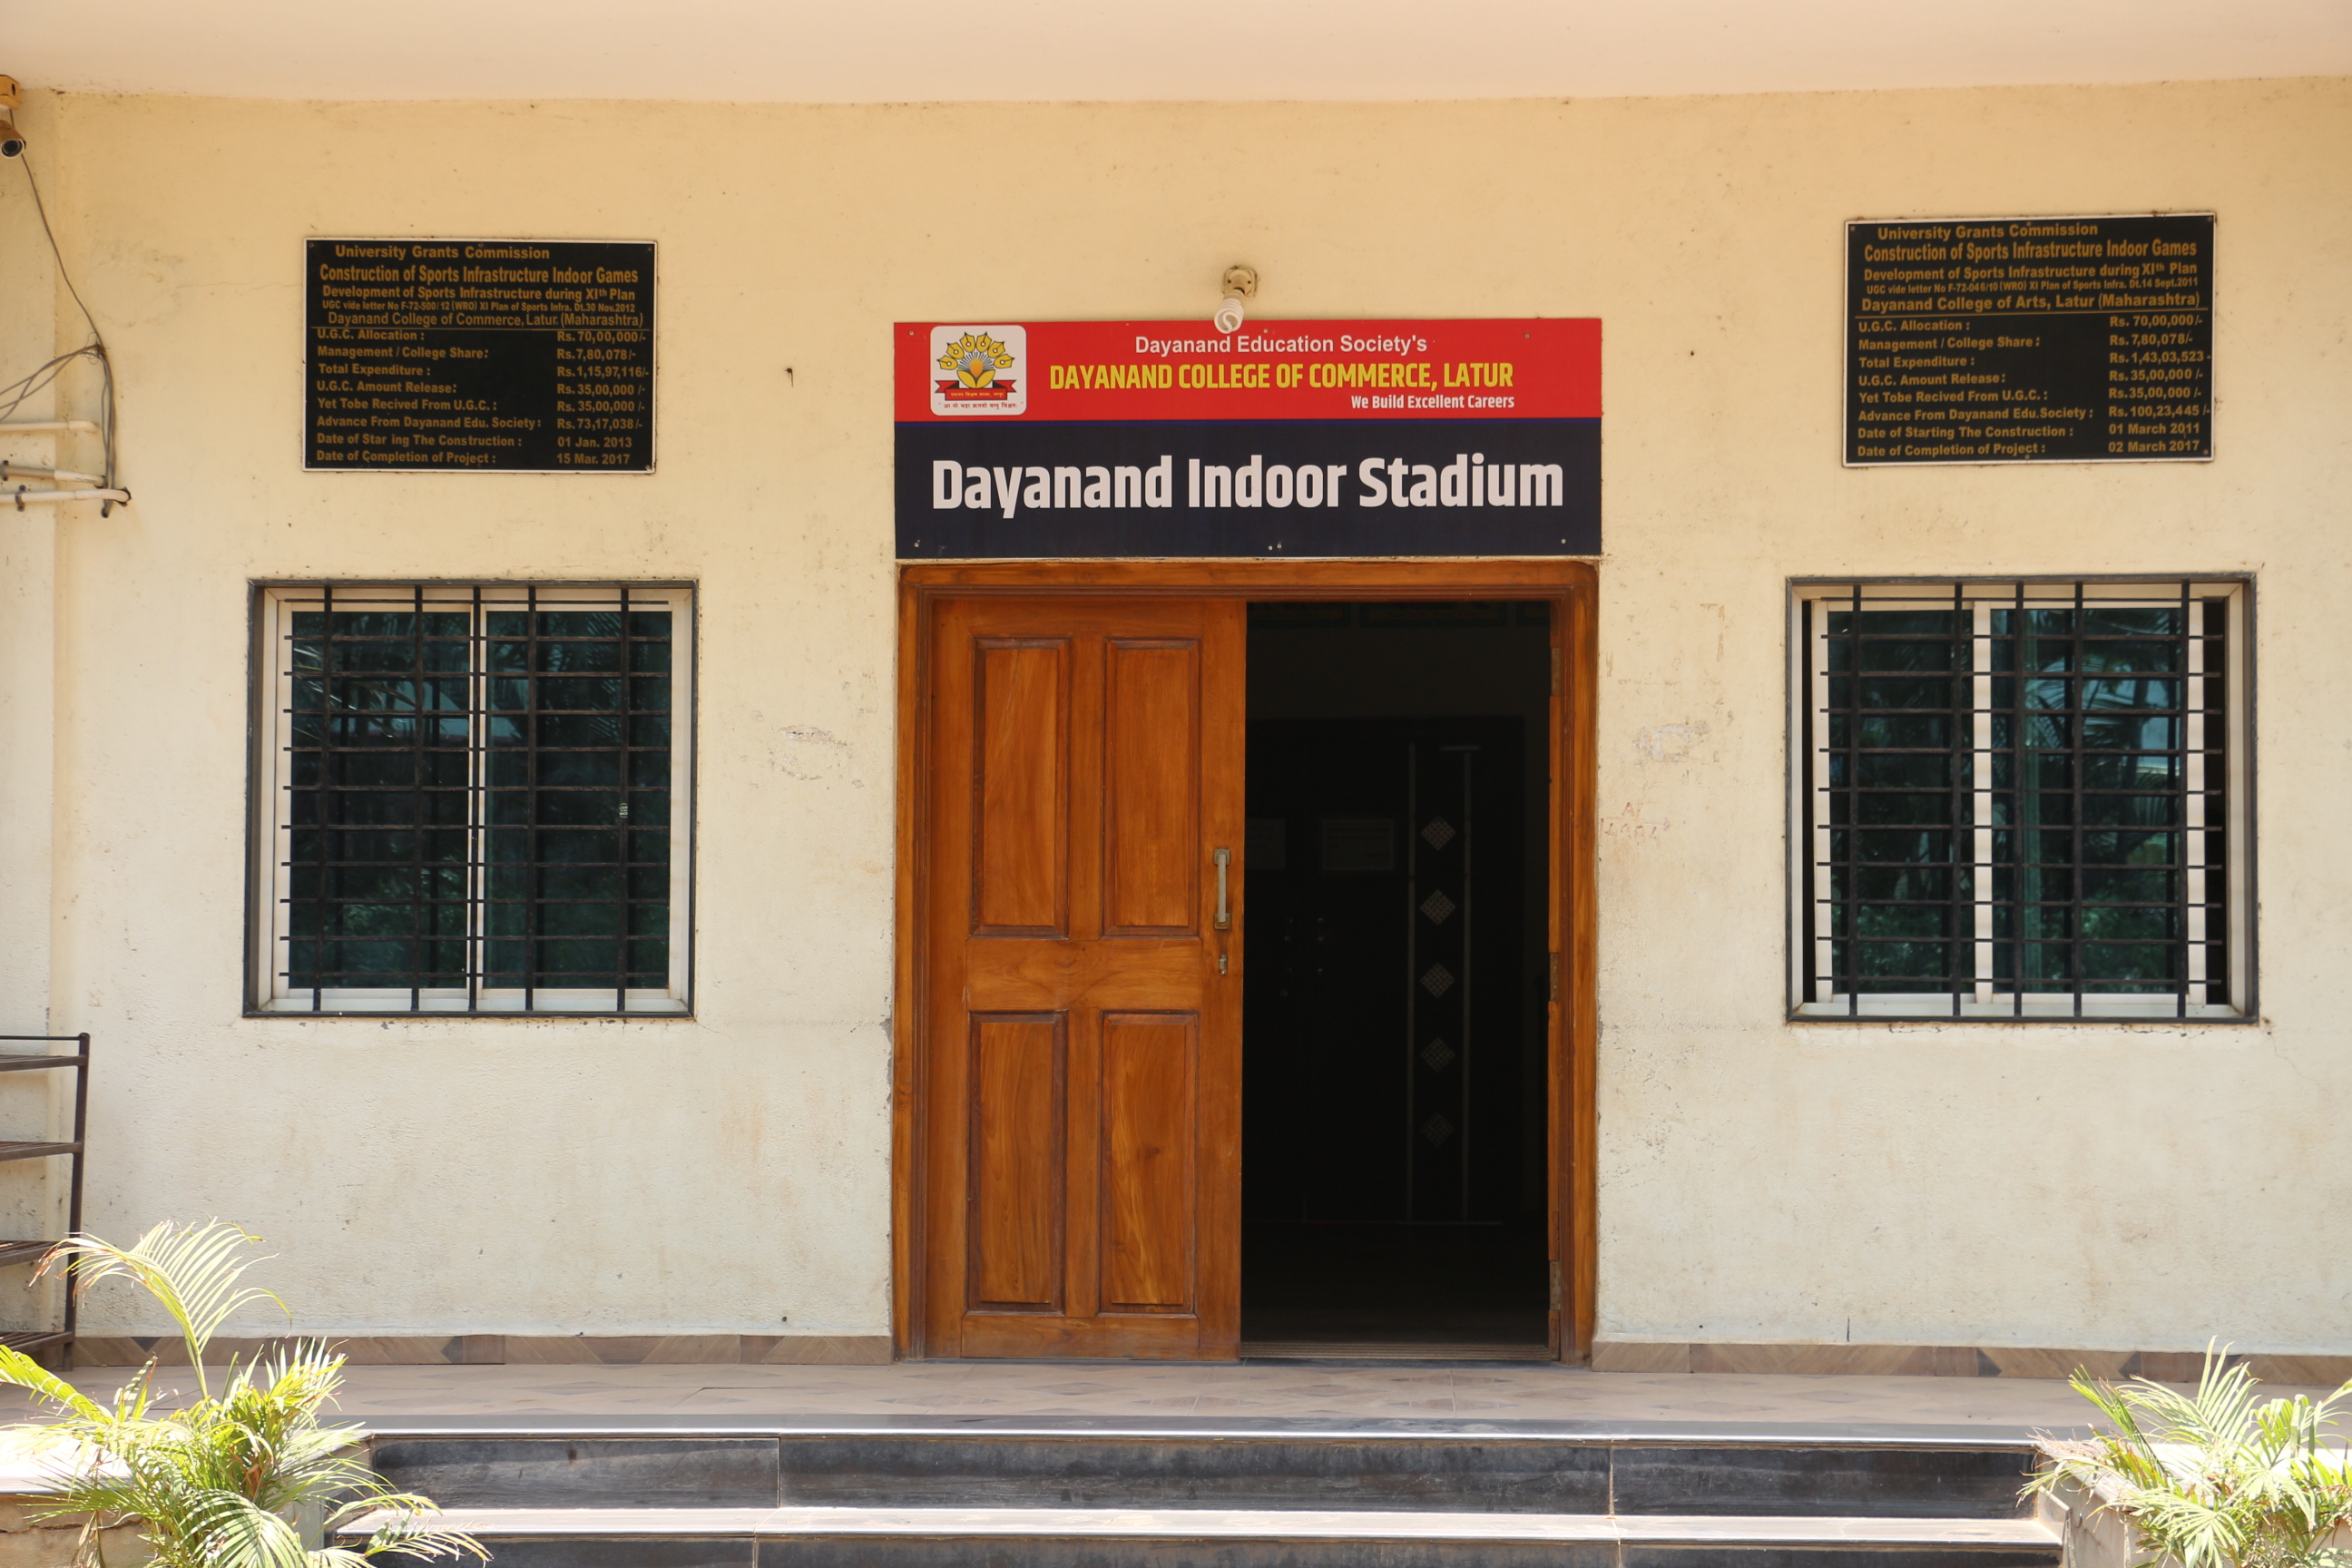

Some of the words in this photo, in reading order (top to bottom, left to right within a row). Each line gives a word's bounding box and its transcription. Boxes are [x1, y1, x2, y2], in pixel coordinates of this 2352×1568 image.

[1877, 226, 1951, 241] University
[1955, 225, 2004, 238] Grants
[2009, 222, 2098, 237] Commission
[335, 244, 407, 260] University
[412, 245, 458, 258] Grants
[465, 245, 549, 259] Commission
[1864, 243, 1946, 261] Construction
[1950, 242, 1964, 260] of
[1966, 241, 2009, 263] Sports
[2013, 240, 2102, 259] Infrastructure
[2106, 240, 2149, 256] Indoor
[2151, 238, 2196, 256] Games
[319, 263, 399, 281] Construction
[403, 264, 416, 281] of
[418, 264, 459, 285] Sports
[463, 265, 549, 282] Infrastructure
[553, 266, 593, 283] Indoor
[595, 266, 638, 283] Games
[1864, 268, 1944, 282] Development
[1947, 267, 1960, 279] of
[1964, 266, 2004, 281] Sports
[2008, 265, 2096, 278] Infrastructure
[2100, 263, 2140, 279] during
[2170, 261, 2197, 274] Plan
[322, 284, 400, 299] Development
[402, 286, 414, 298] of
[417, 286, 456, 300] Sports
[459, 286, 542, 299] Infrastructure
[545, 288, 583, 303] during
[609, 288, 635, 300] Plan
[1867, 284, 1886, 294] UGC
[1887, 284, 1906, 293] vide
[1907, 284, 1932, 293] letter
[1999, 280, 2026, 291] (WRO)
[2041, 280, 2060, 289] Plan
[2073, 279, 2101, 290] Sports
[2103, 279, 2126, 289] Infra.
[2129, 279, 2152, 288] Dt.14
[2154, 277, 2197, 289] Sept.2011
[321, 299, 340, 309] UGC
[342, 300, 360, 309] vide
[362, 300, 386, 310] letter
[451, 300, 477, 311] (WRO)
[490, 300, 509, 310] Plan
[521, 301, 547, 312] Sports
[550, 301, 572, 311] Infra.
[573, 303, 596, 312] Dt.30
[598, 303, 635, 312] Nov.2012
[1861, 297, 1932, 314] Dayanand
[1936, 297, 1993, 312] College
[1996, 295, 2012, 309] of
[2015, 295, 2051, 309] Arts,
[2055, 294, 2094, 307] Latur
[2098, 291, 2200, 309] (Maharashtra)
[328, 311, 388, 327] Dayanand
[392, 312, 436, 328] College
[440, 312, 453, 325] of
[456, 312, 524, 326] Commerce,
[560, 312, 642, 328] (Maharashtra)
[1858, 320, 1896, 332] U.G.C.
[2110, 316, 2129, 327] Rs.
[317, 328, 354, 338] U.G.C.
[557, 330, 575, 341] Rs.
[1136, 337, 1231, 357] Dayanand
[1238, 336, 1334, 352] Education
[1340, 335, 1427, 356] Society's
[1858, 338, 1937, 352] Management
[1946, 337, 1993, 350] College
[2110, 334, 2129, 345] Rs.
[318, 345, 393, 358] Management
[401, 346, 446, 360] College
[557, 348, 575, 359] Rs.
[1858, 357, 1889, 368] Total
[2109, 352, 2129, 363] Rs.
[318, 363, 348, 374] Total
[557, 366, 575, 377] Rs.
[1051, 364, 1172, 389] DAYANAND
[1179, 364, 1270, 388] COLLEGE
[1276, 364, 1303, 388] OF
[1309, 363, 1437, 391] COMMERCE,
[1444, 363, 1514, 387] LATUR
[1858, 375, 1896, 386] U.G.C.
[1900, 374, 1947, 385] Amount
[2109, 370, 2128, 381] Rs.
[317, 380, 353, 391] U.G.C.
[357, 380, 402, 392] Amount
[557, 383, 574, 394] Rs.
[1858, 392, 1878, 403] Yet
[1882, 391, 1912, 402] Tobe
[1916, 390, 1964, 402] Recived
[1967, 390, 1998, 401] From
[2002, 389, 2040, 400] U.G.C.
[2109, 387, 2128, 398] Rs.
[317, 397, 337, 408] Yet
[339, 397, 368, 408] Tobe
[372, 397, 417, 409] Recived
[421, 398, 450, 409] From
[454, 399, 489, 410] U.G.C.
[556, 400, 574, 412] Rs.
[1351, 396, 1368, 408] We
[1372, 396, 1405, 408] Build
[1407, 395, 1465, 408] Excellent
[1467, 395, 1514, 408] Careers
[1857, 410, 1910, 421] Advance
[1915, 409, 1945, 420] From
[1949, 408, 2009, 422] Dayanand
[2109, 406, 2127, 416] Rs.
[317, 416, 367, 426] Advance
[370, 416, 399, 426] From
[404, 416, 461, 429] Dayanand
[464, 416, 488, 427] Edu.
[557, 418, 575, 429] Rs.
[1857, 427, 1886, 438] Date
[1889, 426, 1902, 437] of
[1905, 426, 1955, 440] Starting
[1958, 426, 1982, 437] The
[2109, 423, 2122, 434] 01
[2128, 423, 2166, 434] March
[2170, 422, 2199, 433] 2011
[317, 432, 344, 444] Date
[347, 433, 358, 444] of
[412, 434, 435, 445] The
[557, 436, 570, 446] 01
[575, 436, 599, 446] Jan.
[603, 436, 632, 447] 2013
[1857, 445, 1886, 456] Date
[1888, 445, 1901, 456] of
[1905, 444, 1974, 457] Completion
[1977, 443, 1990, 454] of
[2108, 441, 2123, 452] 02
[2127, 440, 2166, 452] March
[2169, 439, 2200, 451] 2017
[317, 449, 343, 460] Date
[347, 450, 358, 460] of
[361, 450, 427, 464] Completion
[431, 451, 443, 462] of
[556, 453, 570, 464] 15
[574, 453, 598, 464] Mar.
[602, 454, 630, 464] 2017
[932, 456, 1172, 519] Dayanand
[1188, 455, 1347, 508] Indoor
[1359, 453, 1563, 508] Stadium
